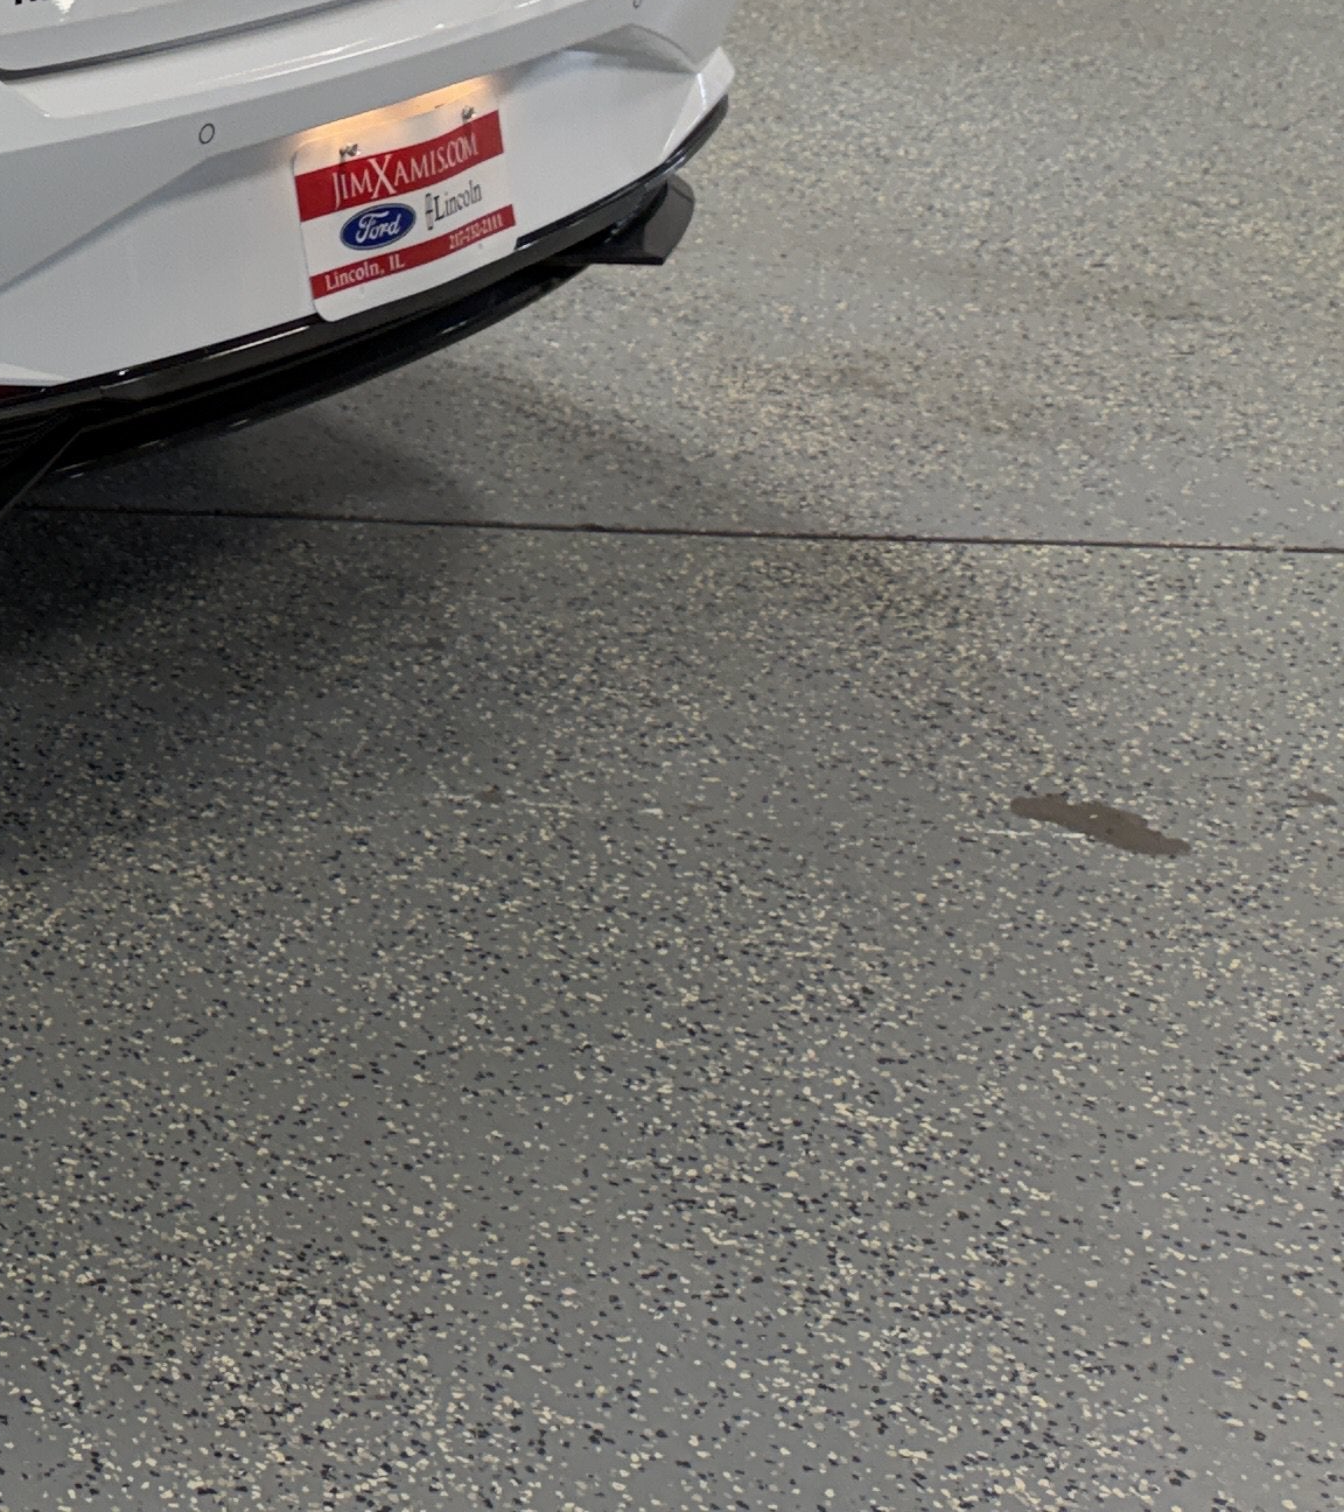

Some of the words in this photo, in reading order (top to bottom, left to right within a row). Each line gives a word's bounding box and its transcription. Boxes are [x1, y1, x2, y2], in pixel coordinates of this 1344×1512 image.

[355, 211, 401, 244] Ford
[325, 261, 385, 291] Lincoln,
[389, 254, 405, 271] IL
